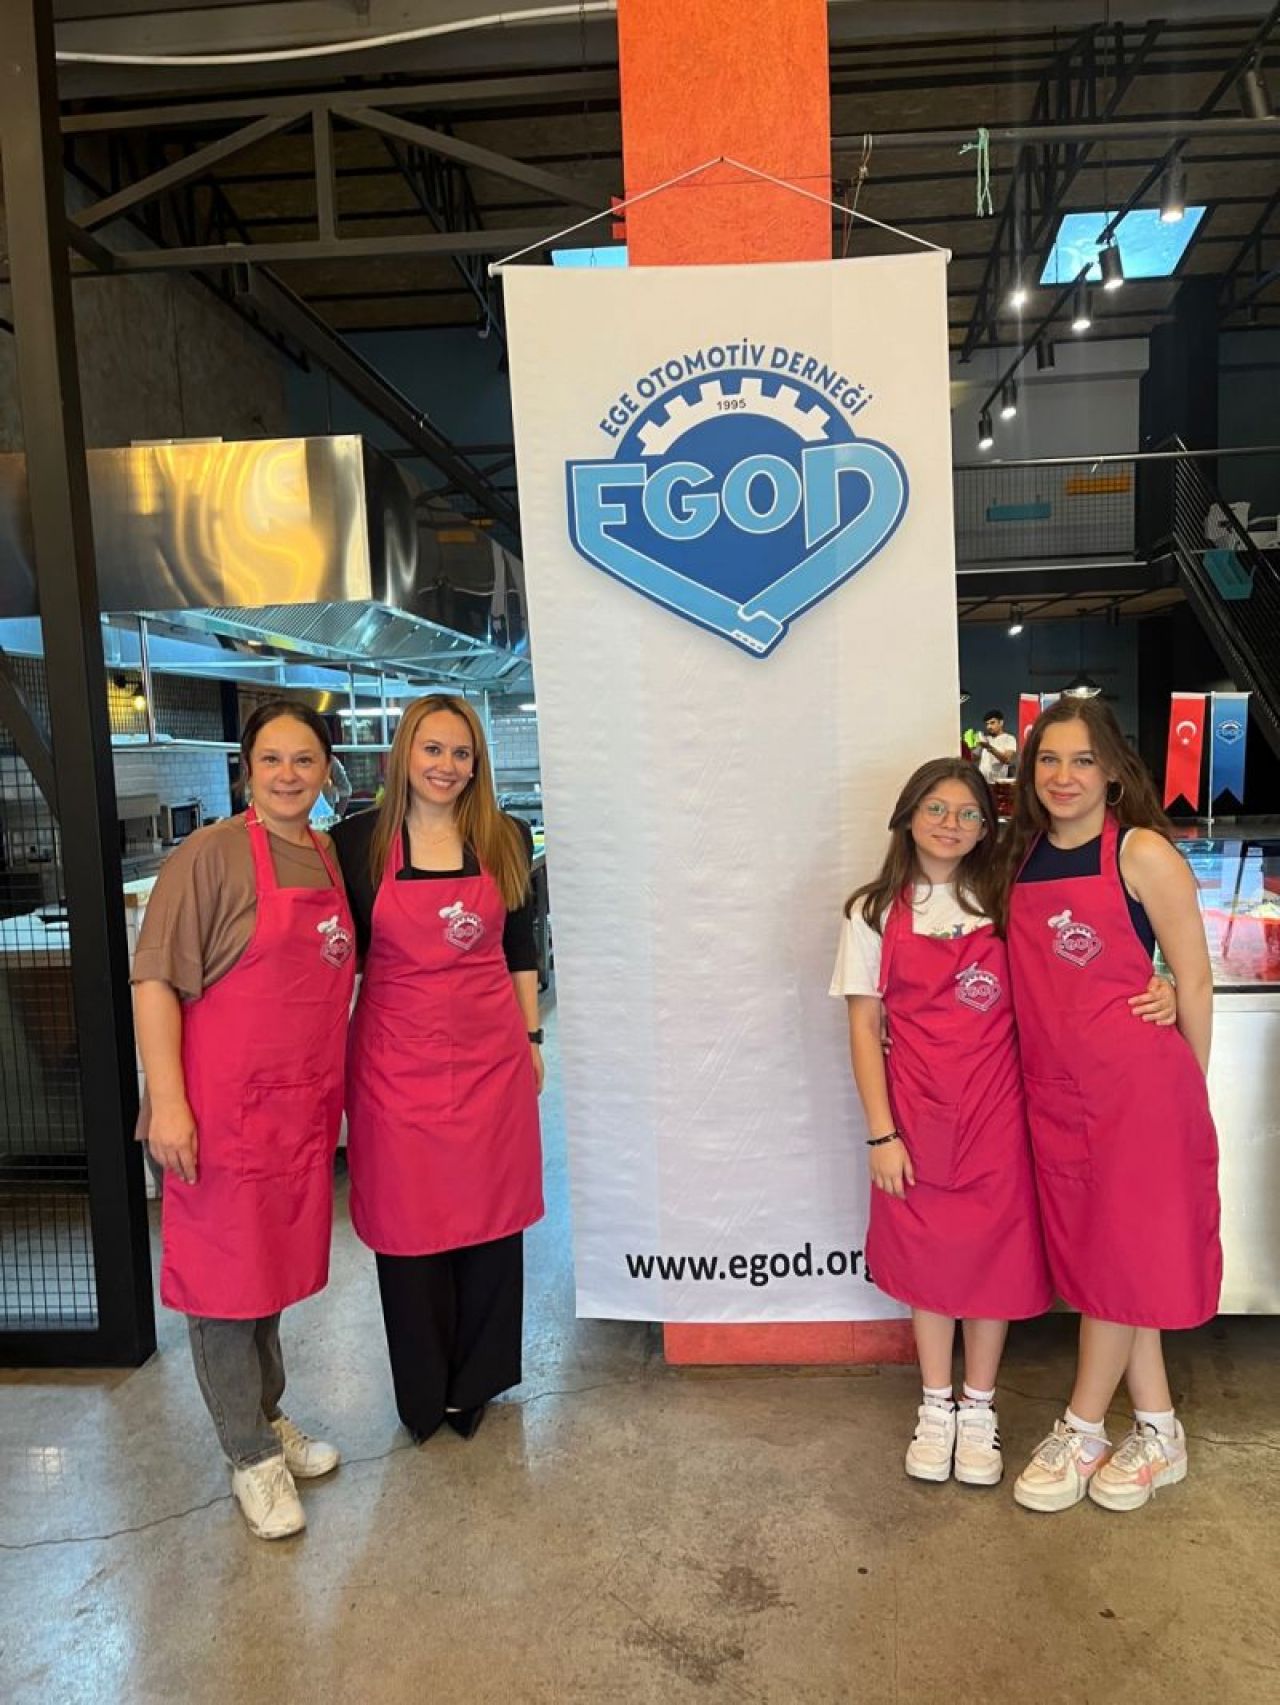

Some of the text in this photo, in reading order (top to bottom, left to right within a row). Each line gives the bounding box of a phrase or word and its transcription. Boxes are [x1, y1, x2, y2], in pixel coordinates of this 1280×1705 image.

[600, 338, 873, 438] EGE OTOMOTİV DERNEĞİ
[716, 398, 747, 411] 1995
[571, 442, 905, 568] EGOD
[626, 1243, 873, 1286] www.egod.or
